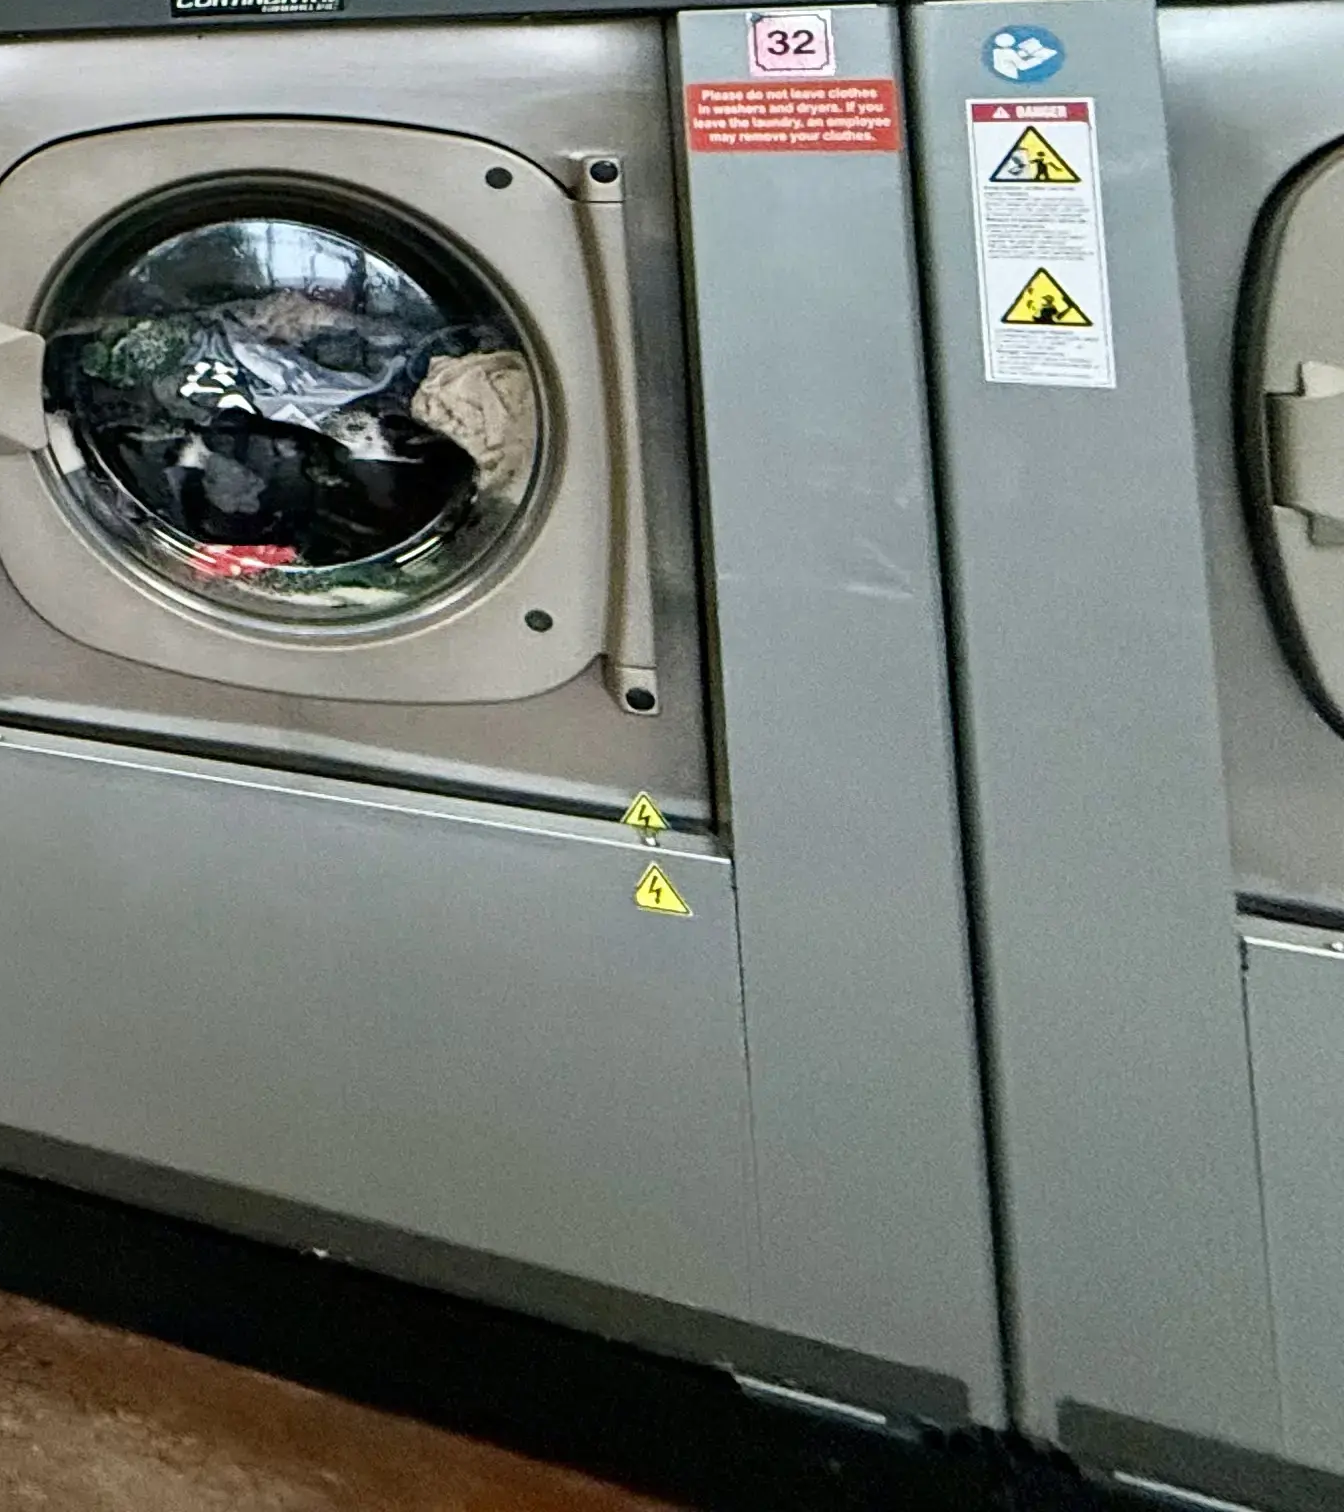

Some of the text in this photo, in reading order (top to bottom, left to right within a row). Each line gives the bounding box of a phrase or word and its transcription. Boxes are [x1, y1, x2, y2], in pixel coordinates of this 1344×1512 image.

[767, 29, 816, 56] 32
[701, 87, 878, 101] Please do not leave clothes
[713, 102, 766, 114] washers
[769, 101, 794, 113] and
[797, 102, 843, 116] dryers.
[858, 103, 884, 116] you
[693, 116, 727, 129] leave
[729, 117, 750, 128] the
[807, 118, 824, 128] an
[826, 116, 891, 130] employee
[709, 132, 736, 145] may
[738, 131, 788, 142] remove
[790, 131, 820, 144] your
